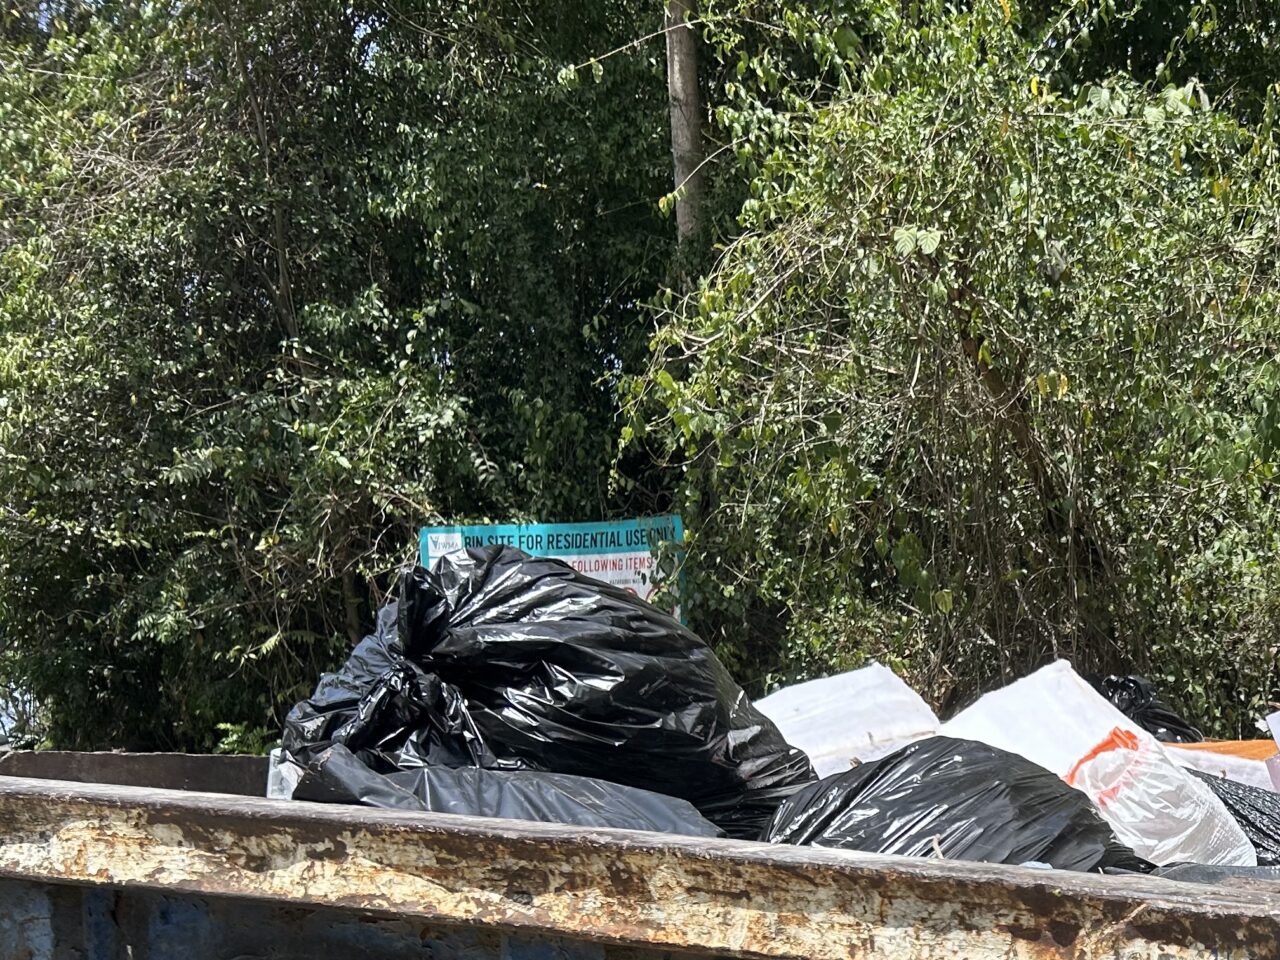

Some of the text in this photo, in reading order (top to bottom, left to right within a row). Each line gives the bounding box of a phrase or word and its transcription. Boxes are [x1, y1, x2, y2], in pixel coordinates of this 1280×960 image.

[464, 535, 483, 548] BIN
[518, 533, 543, 550] FOR
[547, 530, 623, 550] RESIDENTIAL
[625, 528, 647, 546] USE
[572, 557, 623, 573] FOLLOWING
